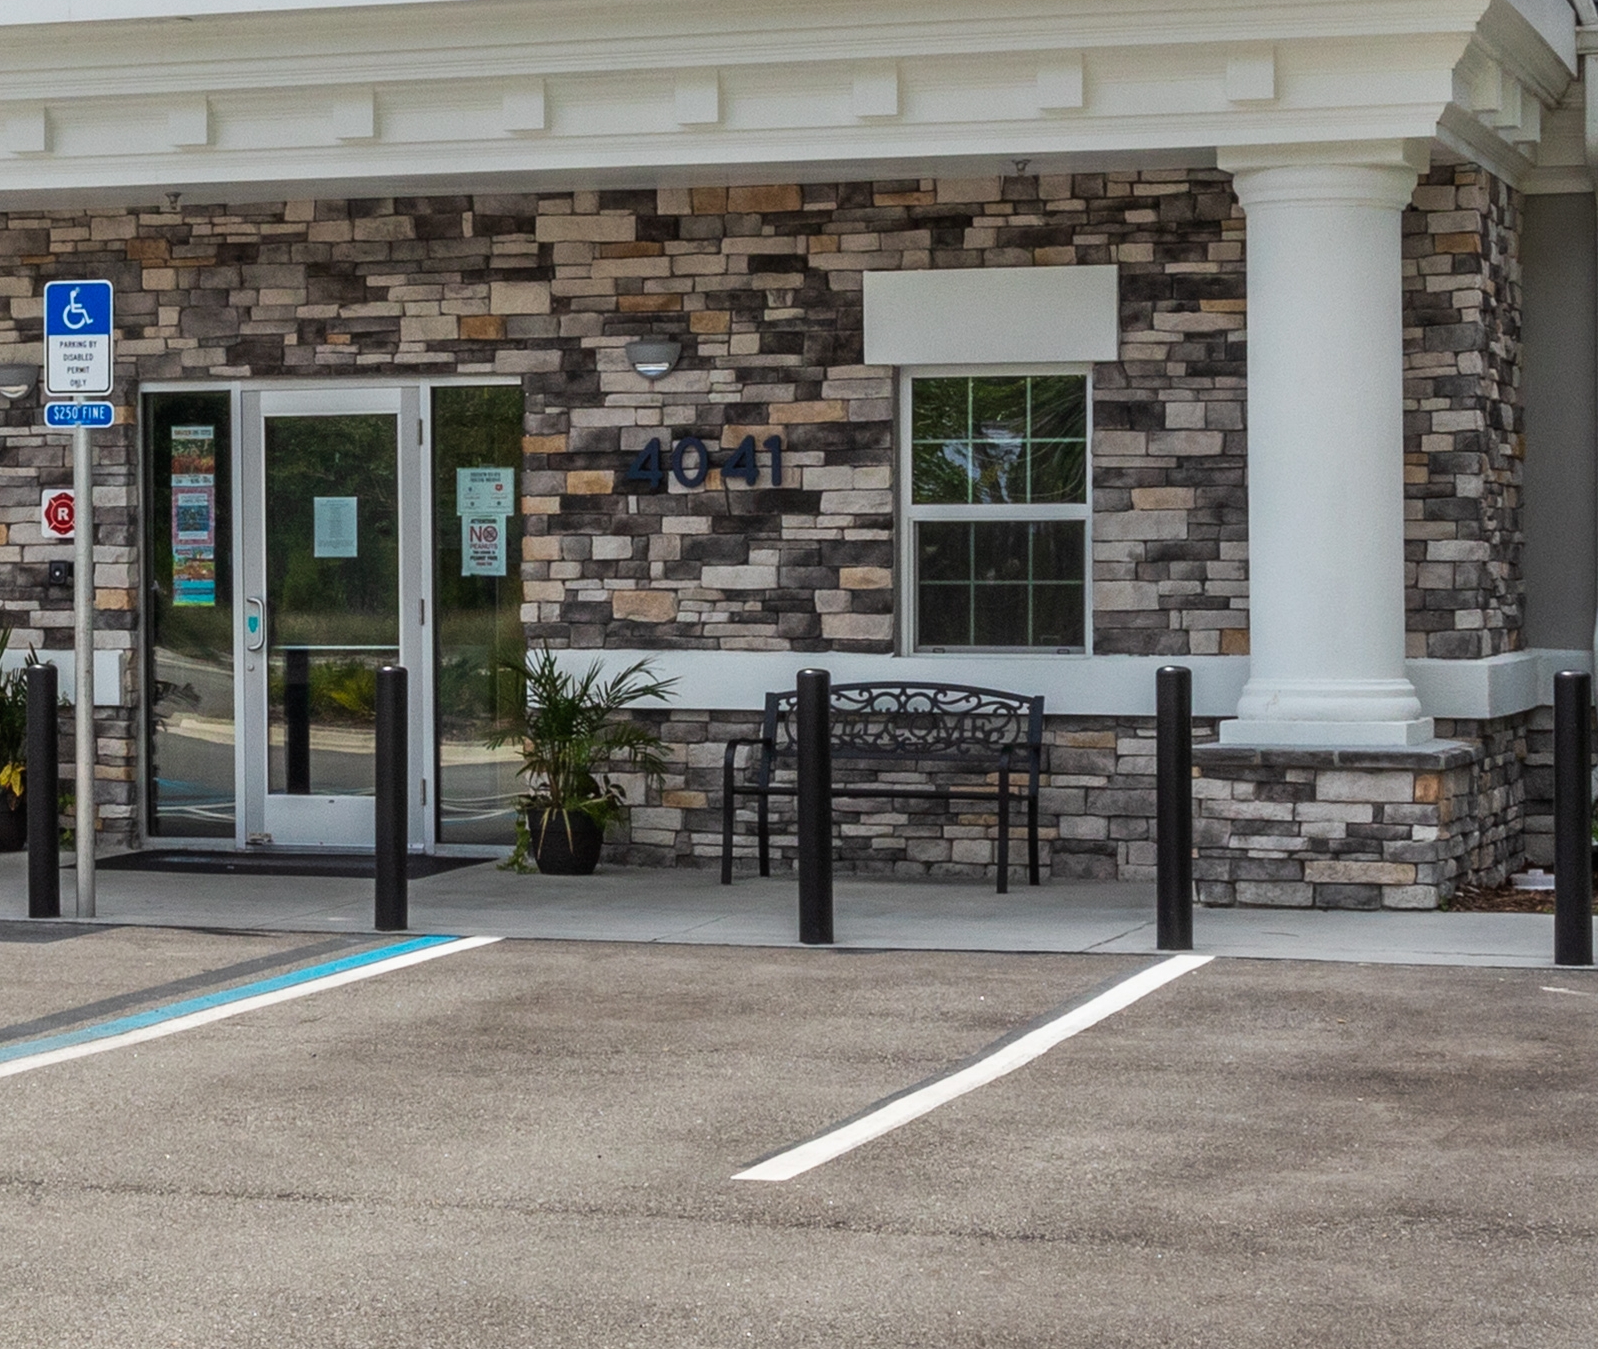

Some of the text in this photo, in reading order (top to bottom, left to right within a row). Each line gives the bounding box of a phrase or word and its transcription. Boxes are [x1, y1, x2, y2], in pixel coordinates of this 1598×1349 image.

[63, 353, 93, 361] DISABLED
[67, 366, 90, 374] PERMIT
[70, 379, 87, 387] ONLY
[54, 406, 105, 420] $250 FINE
[627, 435, 782, 488] 4041
[57, 507, 70, 521] R
[830, 714, 991, 739] ELCOME
